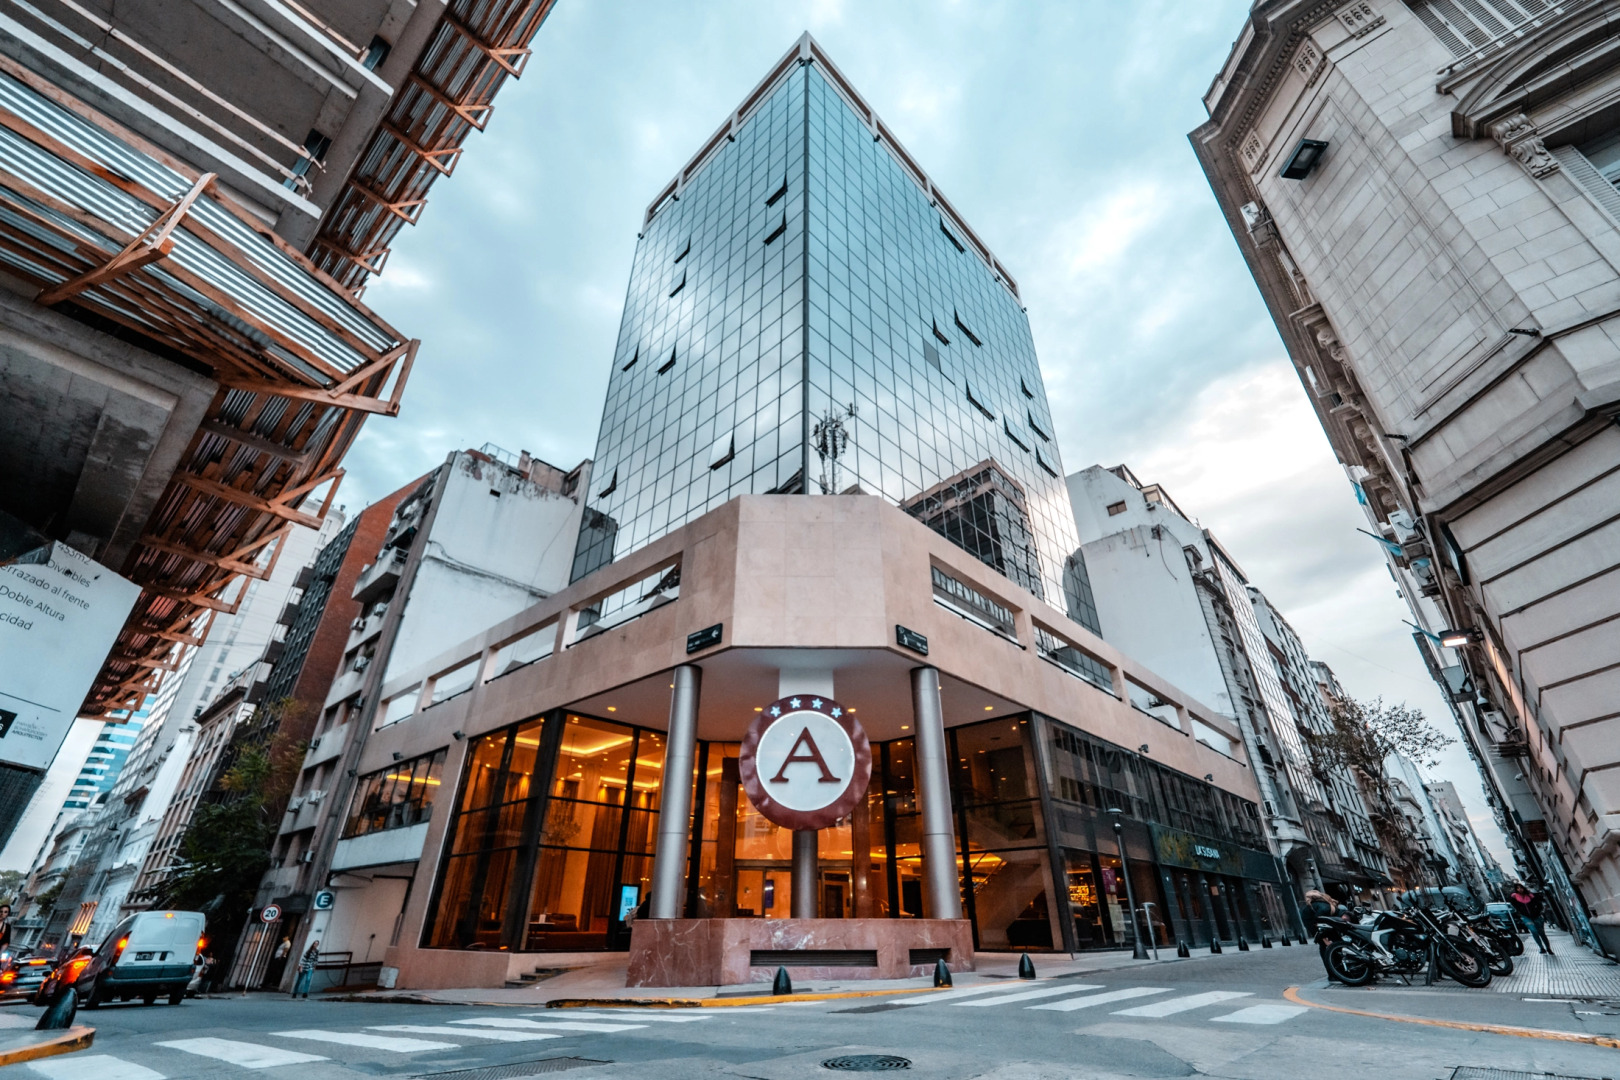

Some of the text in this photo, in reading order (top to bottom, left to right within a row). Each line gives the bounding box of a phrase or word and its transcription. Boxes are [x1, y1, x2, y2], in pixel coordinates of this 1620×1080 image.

[46, 559, 91, 588] Divibles
[0, 584, 66, 622] Doble Altura
[51, 587, 62, 596] al
[61, 590, 90, 610] frente
[770, 726, 841, 784] A
[264, 909, 277, 918] 20
[320, 895, 330, 906] E
